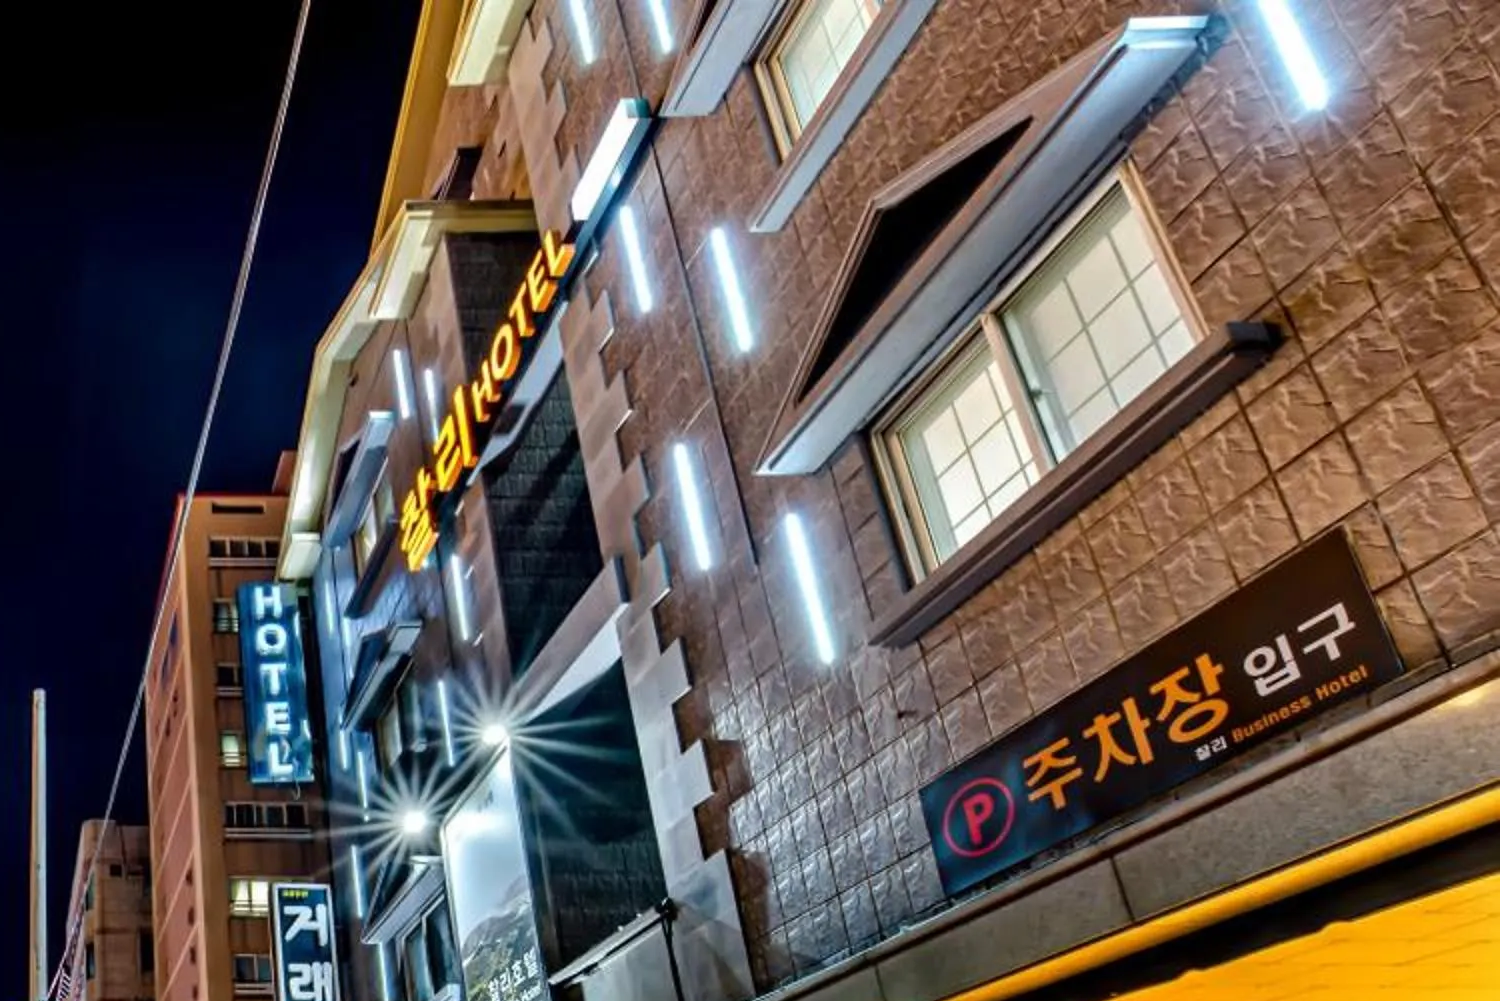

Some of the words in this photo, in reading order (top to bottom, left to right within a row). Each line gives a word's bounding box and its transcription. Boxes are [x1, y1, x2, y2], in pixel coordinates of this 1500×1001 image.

[469, 230, 575, 422] HOTEL
[254, 586, 293, 776] HOTEL
[1023, 653, 1229, 809] 주차장
[1243, 602, 1356, 697] 입구
[1232, 695, 1312, 742] Business
[1316, 664, 1368, 700] Hotel
